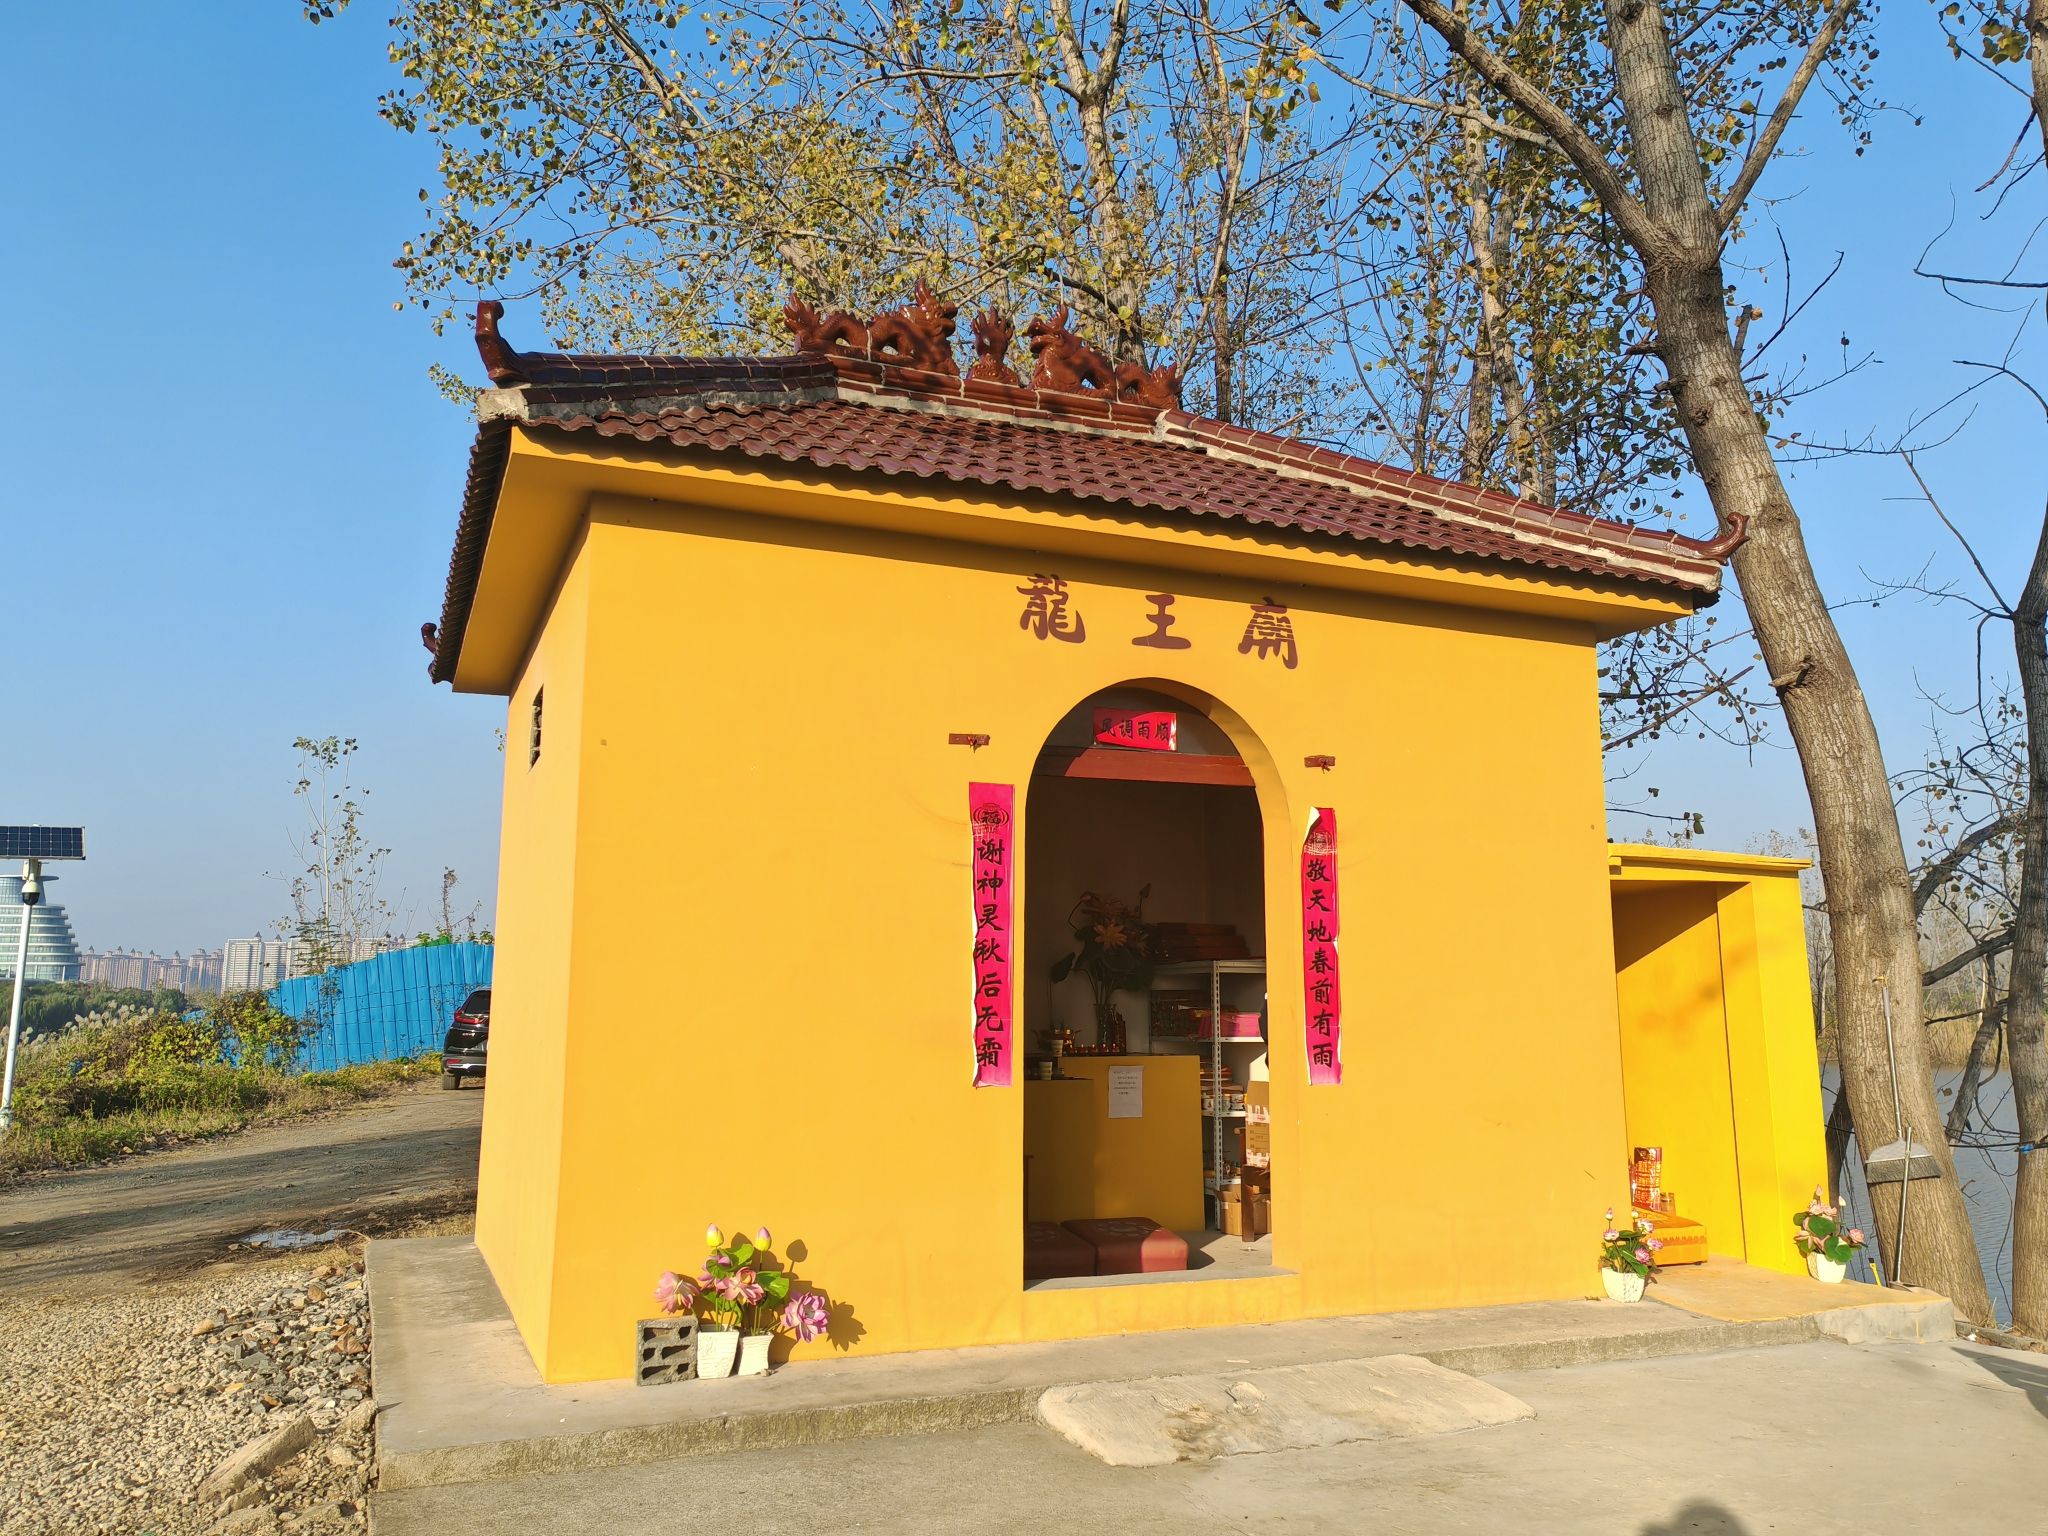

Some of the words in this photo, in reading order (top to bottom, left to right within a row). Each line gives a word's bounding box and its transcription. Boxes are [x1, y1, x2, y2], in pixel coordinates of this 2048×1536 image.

[974, 838, 1006, 1068] 谢神灵秋后无霜
[1306, 857, 1335, 1069] 敬天地春前有雨
